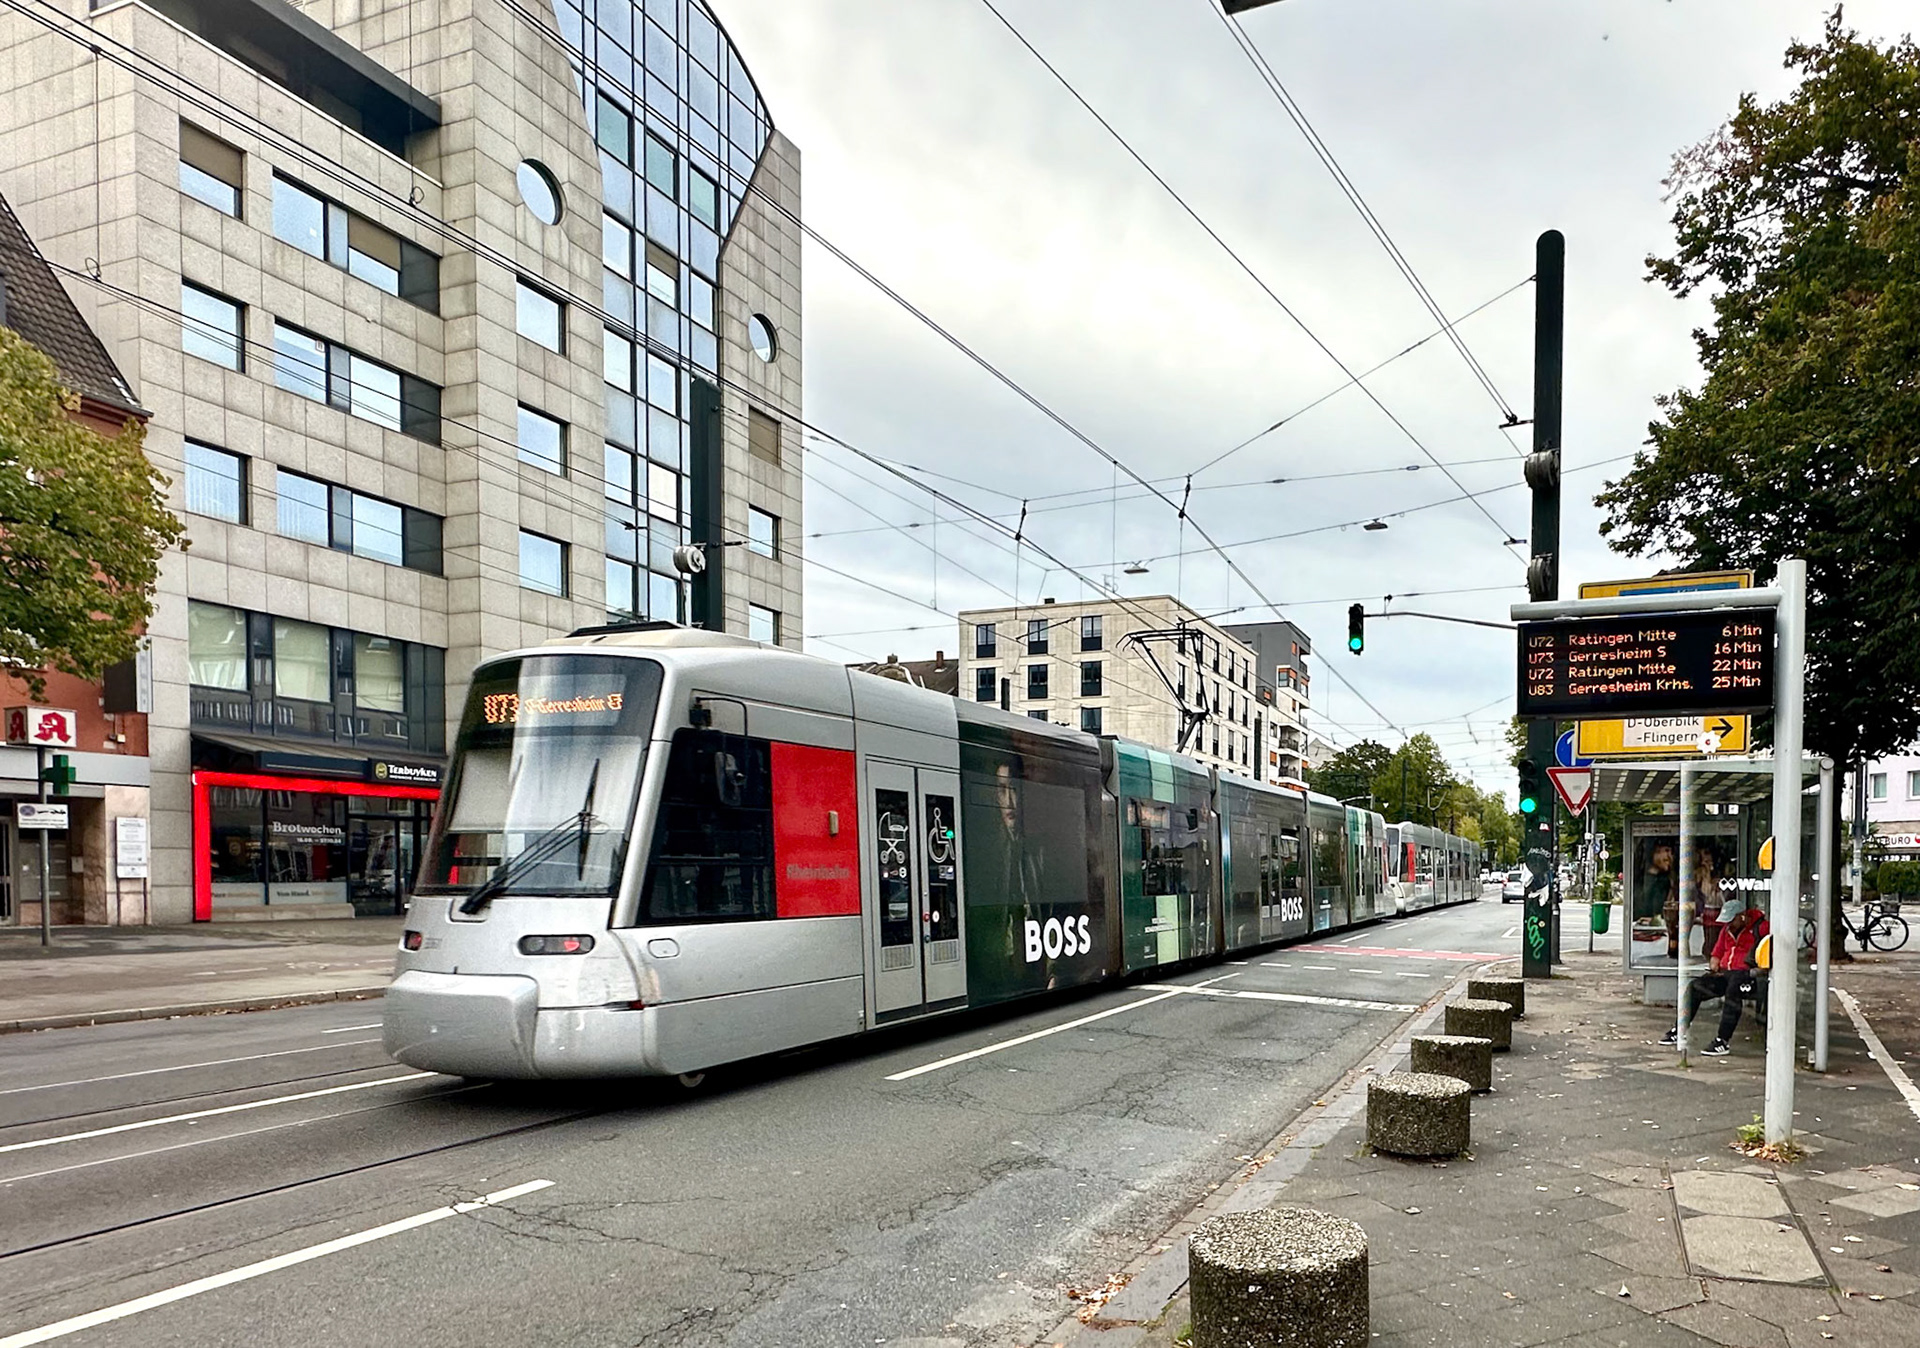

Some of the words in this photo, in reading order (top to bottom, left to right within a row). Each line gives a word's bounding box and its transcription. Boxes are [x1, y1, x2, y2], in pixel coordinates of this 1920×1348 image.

[1529, 636, 1554, 648] U72
[1568, 633, 1633, 646] Ratingen
[1638, 630, 1677, 642] Mitte
[1722, 626, 1732, 637] 6
[1734, 624, 1762, 637] Min
[1528, 652, 1554, 664] U73
[1568, 647, 1652, 662] Gerresheim
[1657, 646, 1667, 657] S
[1714, 643, 1731, 655] 16
[1733, 641, 1762, 654] Min
[1528, 668, 1554, 680] U72
[1568, 666, 1633, 679] Ratingen
[1637, 663, 1677, 675] Mitte
[1712, 659, 1731, 672] 22
[1733, 658, 1762, 671] Min
[1528, 684, 1554, 696] U83
[1568, 680, 1651, 695] Gerresheim
[1656, 678, 1694, 691] Krhs.
[1712, 676, 1731, 689] 25
[1733, 675, 1761, 688] Min
[1627, 716, 1700, 728] D-Oberbilk
[1636, 732, 1698, 745] -Flingern
[272, 821, 342, 835] Brotwochen
[1281, 896, 1304, 922] BOSS
[1024, 914, 1092, 963] BOSS
